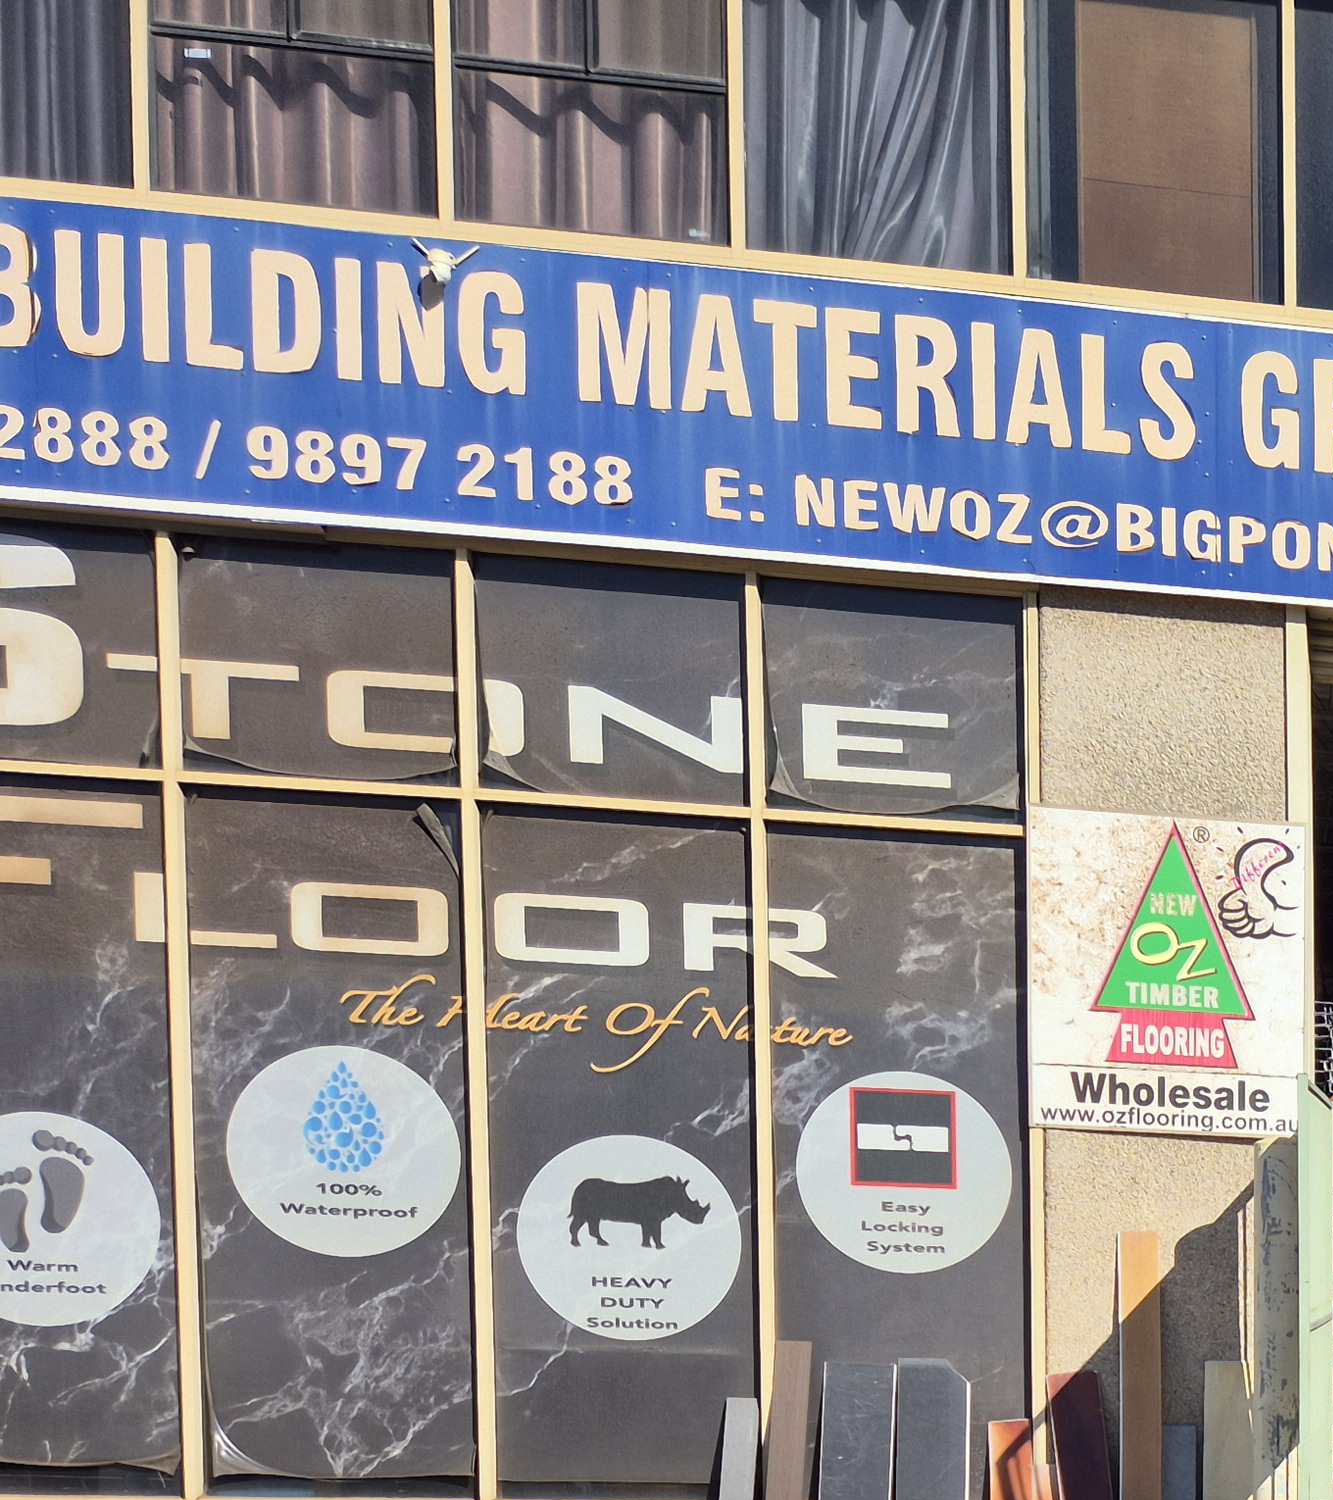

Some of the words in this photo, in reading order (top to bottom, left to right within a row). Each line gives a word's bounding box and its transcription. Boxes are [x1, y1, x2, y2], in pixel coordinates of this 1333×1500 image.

[0, 223, 526, 396] BUILDING
[576, 281, 1197, 461] MATERIALS
[0, 407, 170, 472] 2888
[195, 420, 222, 480] /
[246, 424, 426, 491] 9897
[456, 444, 635, 507] 2188
[705, 466, 765, 523] E:
[0, 533, 953, 789] TONE
[0, 795, 839, 979] LOOR
[1150, 892, 1197, 918] NEW
[1130, 921, 1218, 982] OZ
[1125, 980, 1219, 1010] TIMBER
[340, 974, 437, 1029] The
[590, 987, 711, 1074] Of
[701, 1006, 853, 1048] Nature
[1120, 1022, 1225, 1059] FLOORING
[1070, 1070, 1271, 1113] Wholesale
[1040, 1106, 1299, 1134] www.ozflooring.com.au
[315, 1181, 383, 1198] 100%
[280, 1201, 418, 1220] Waterproof
[881, 1201, 931, 1217] Easy
[861, 1220, 945, 1237] Locking
[866, 1240, 946, 1257] System
[7, 1259, 79, 1274] Warm
[591, 1275, 673, 1290] HEAVY
[600, 1296, 665, 1310] DUTY
[586, 1316, 679, 1331] Solution
